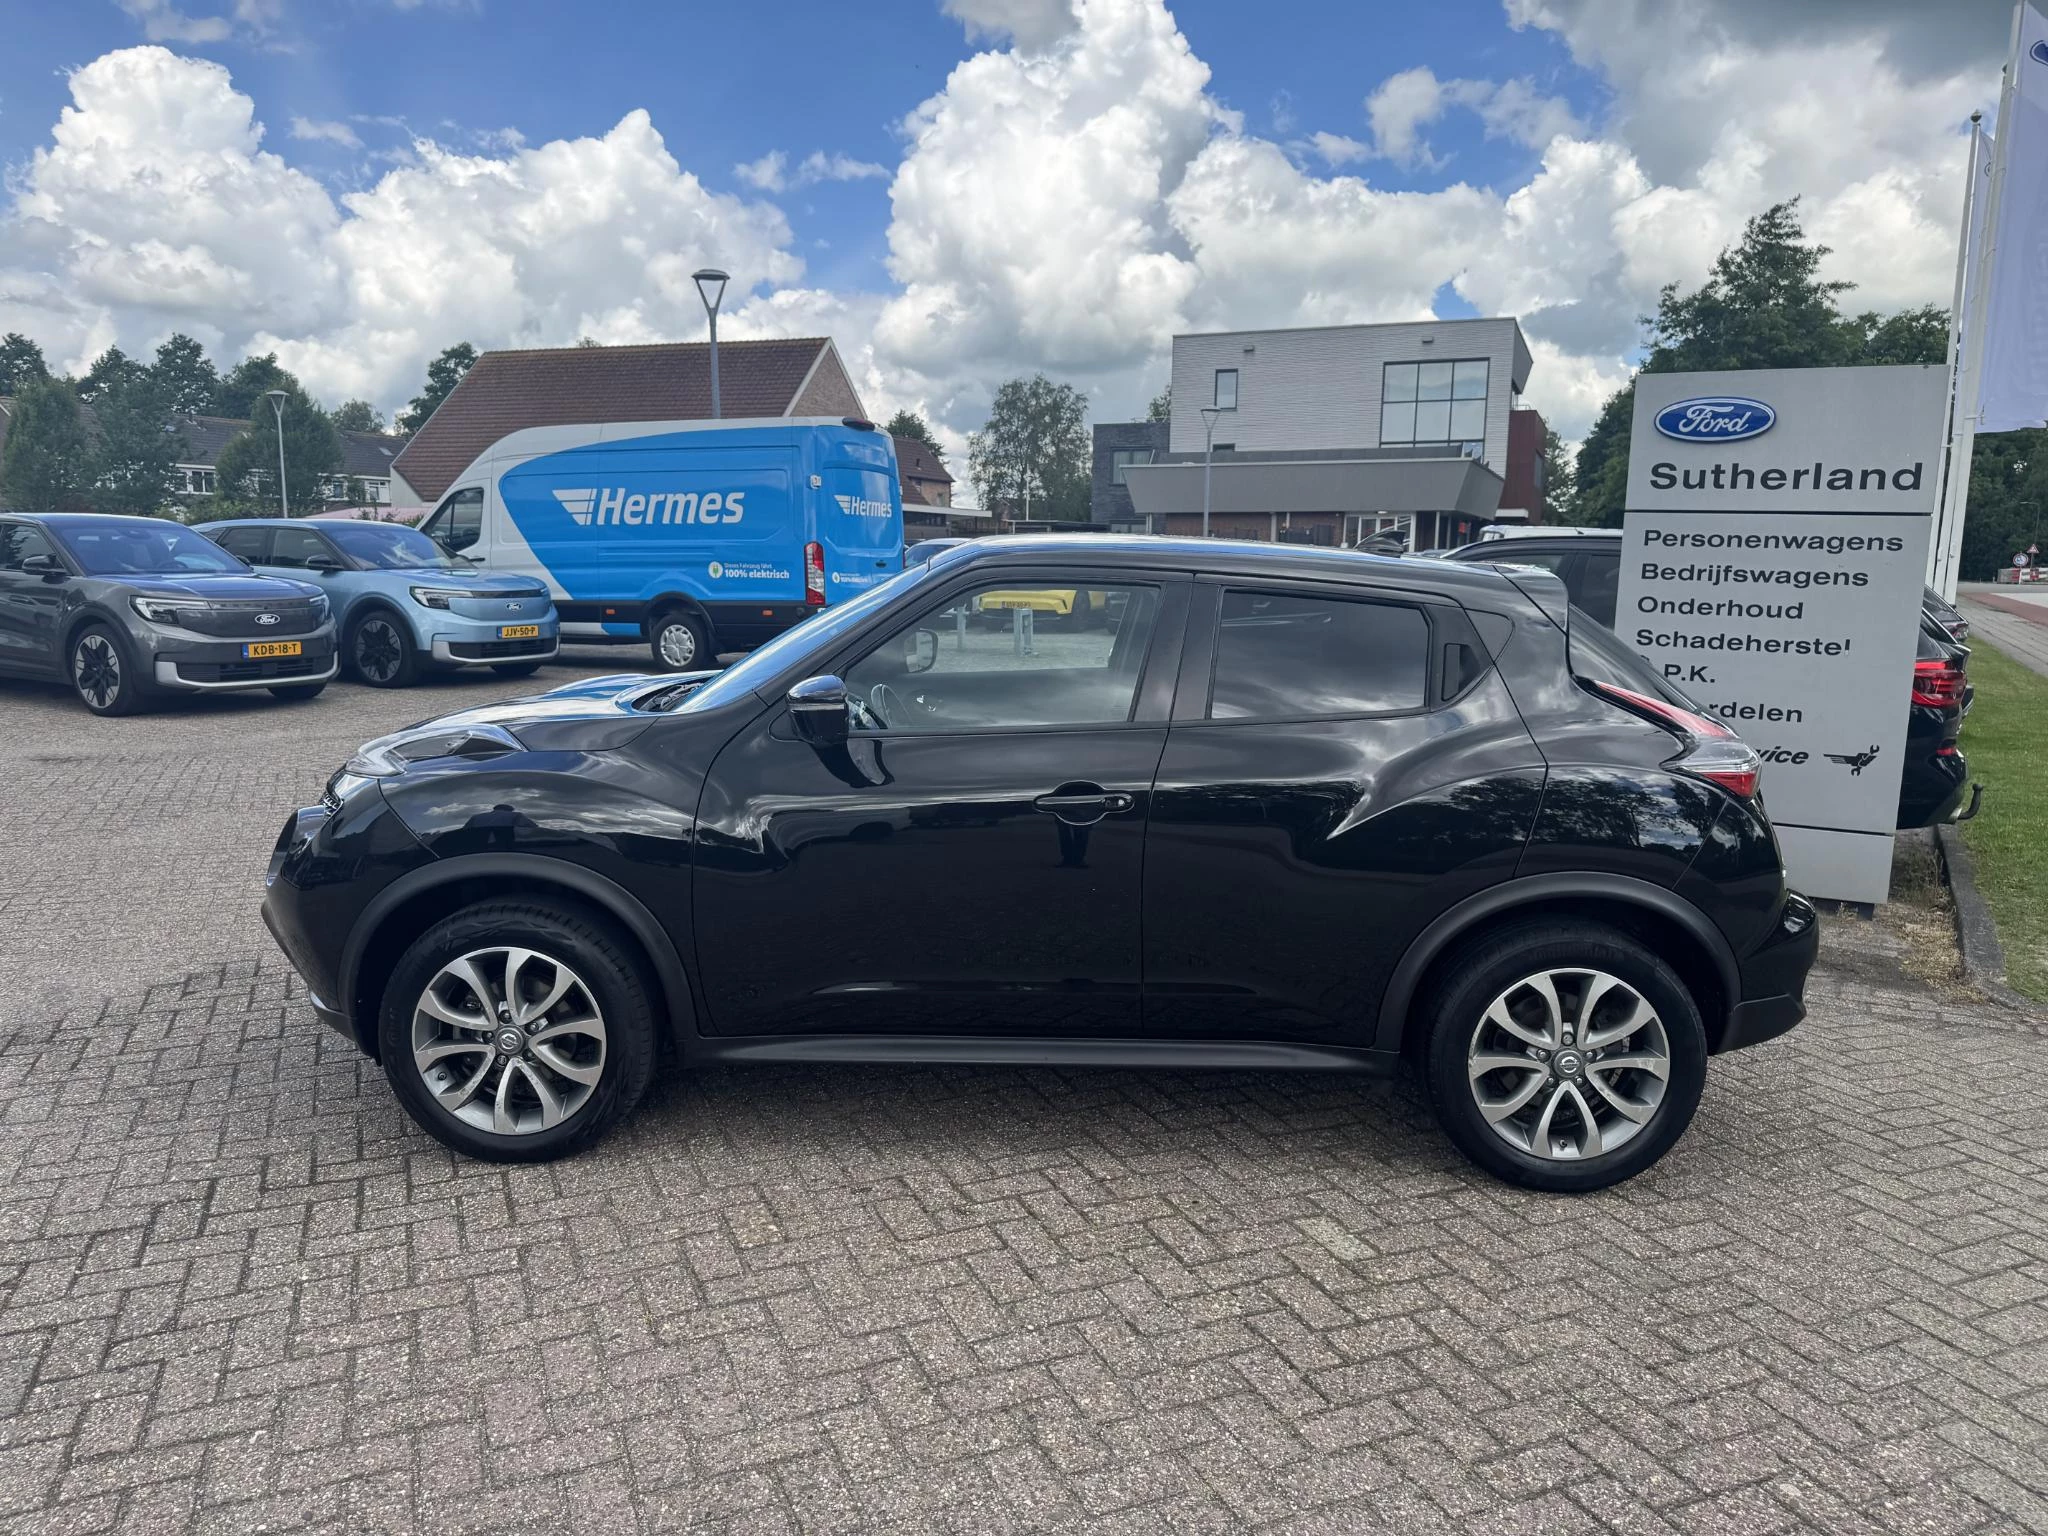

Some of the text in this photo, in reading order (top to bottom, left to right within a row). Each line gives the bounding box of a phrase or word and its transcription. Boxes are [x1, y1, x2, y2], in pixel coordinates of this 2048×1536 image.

[1678, 405, 1751, 433] Ford
[1650, 462, 1923, 490] Sutherland
[597, 487, 745, 526] Hermes
[851, 496, 892, 518] Hermes
[1643, 529, 1904, 555] Personenwagens
[724, 569, 790, 579] 100% elektrisch
[1640, 563, 1869, 589] Bedrijfswagens
[1637, 596, 1803, 619] Onderhoud
[253, 643, 297, 656] KDB-18-T
